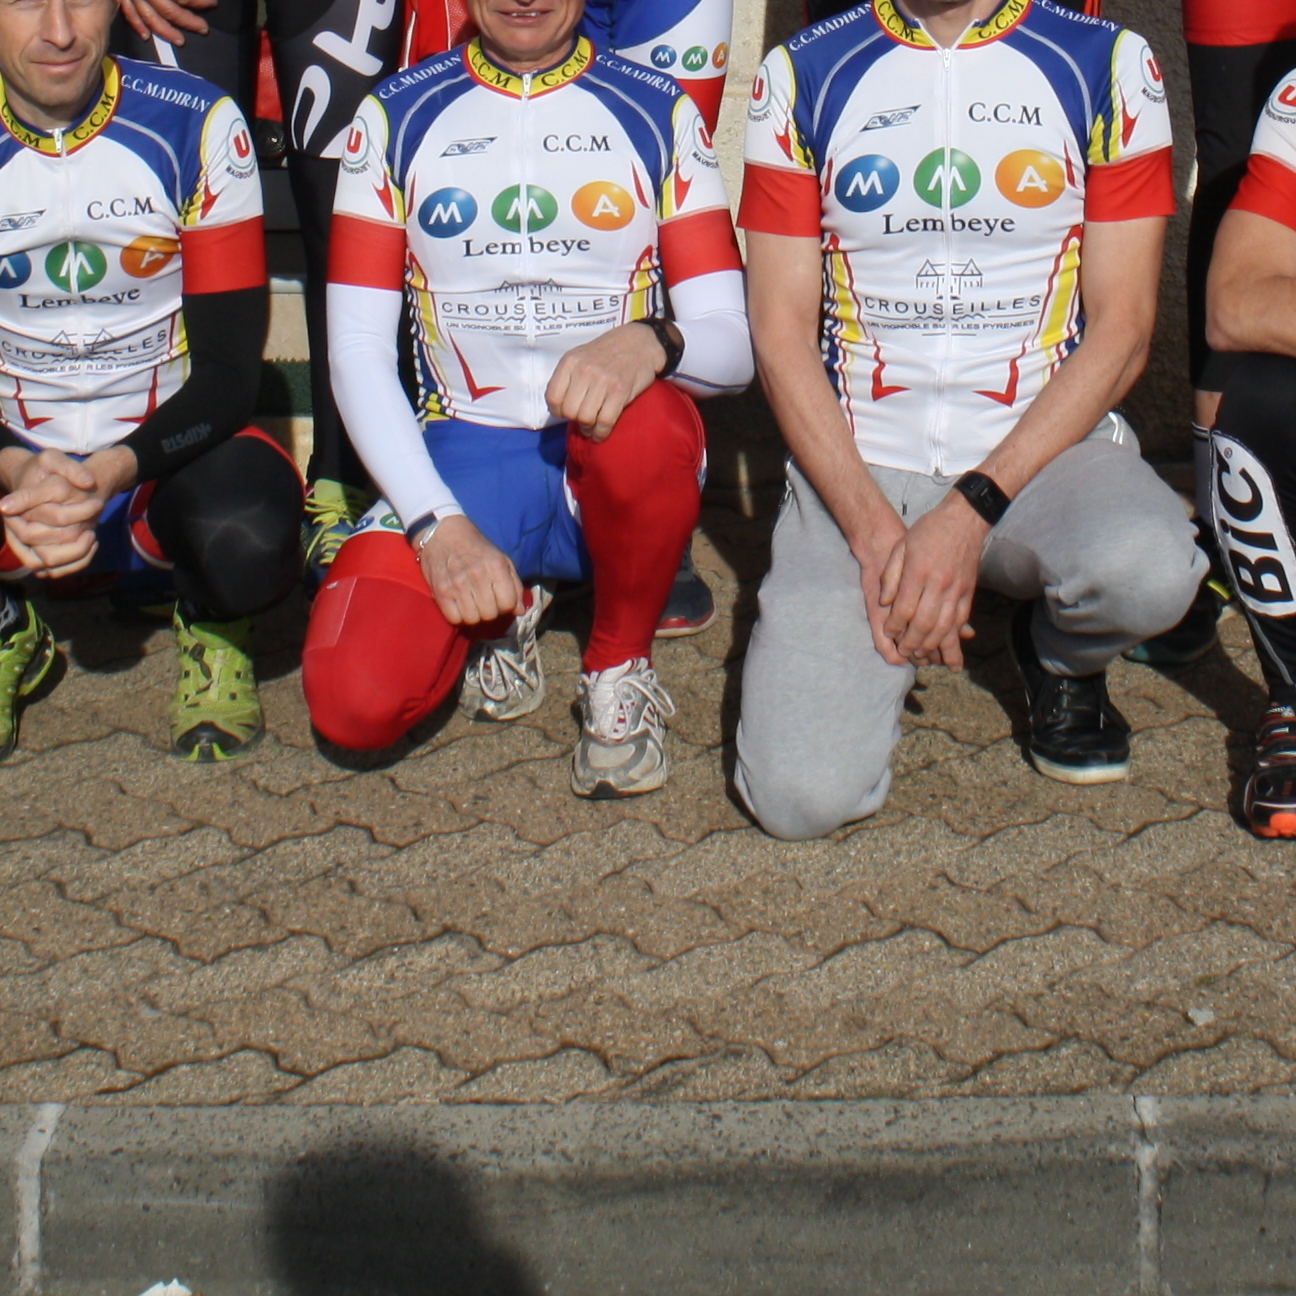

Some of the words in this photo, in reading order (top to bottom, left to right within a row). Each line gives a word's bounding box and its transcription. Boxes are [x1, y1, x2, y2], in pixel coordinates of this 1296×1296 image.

[789, 1, 873, 53] C.C.MADIRAN
[876, 1, 917, 43] C.C.M
[378, 54, 463, 100] C.C.MADIRAN
[470, 50, 513, 90] C.C.M
[540, 50, 589, 88] C.C.M
[595, 54, 681, 98] C.C.MADIRAN
[120, 73, 210, 113] C.C.MADIRAN
[72, 91, 115, 142] C.C.M
[968, 101, 1044, 127] C.C.M
[232, 129, 252, 159] U
[347, 127, 363, 152] U
[543, 134, 611, 153] C.C.M
[86, 196, 155, 221] C.C.M
[882, 213, 1016, 237] Lembeye
[463, 236, 591, 257] Lembeye
[441, 295, 621, 317] CROUSEILLES
[863, 294, 1042, 316] CROUSEILLES
